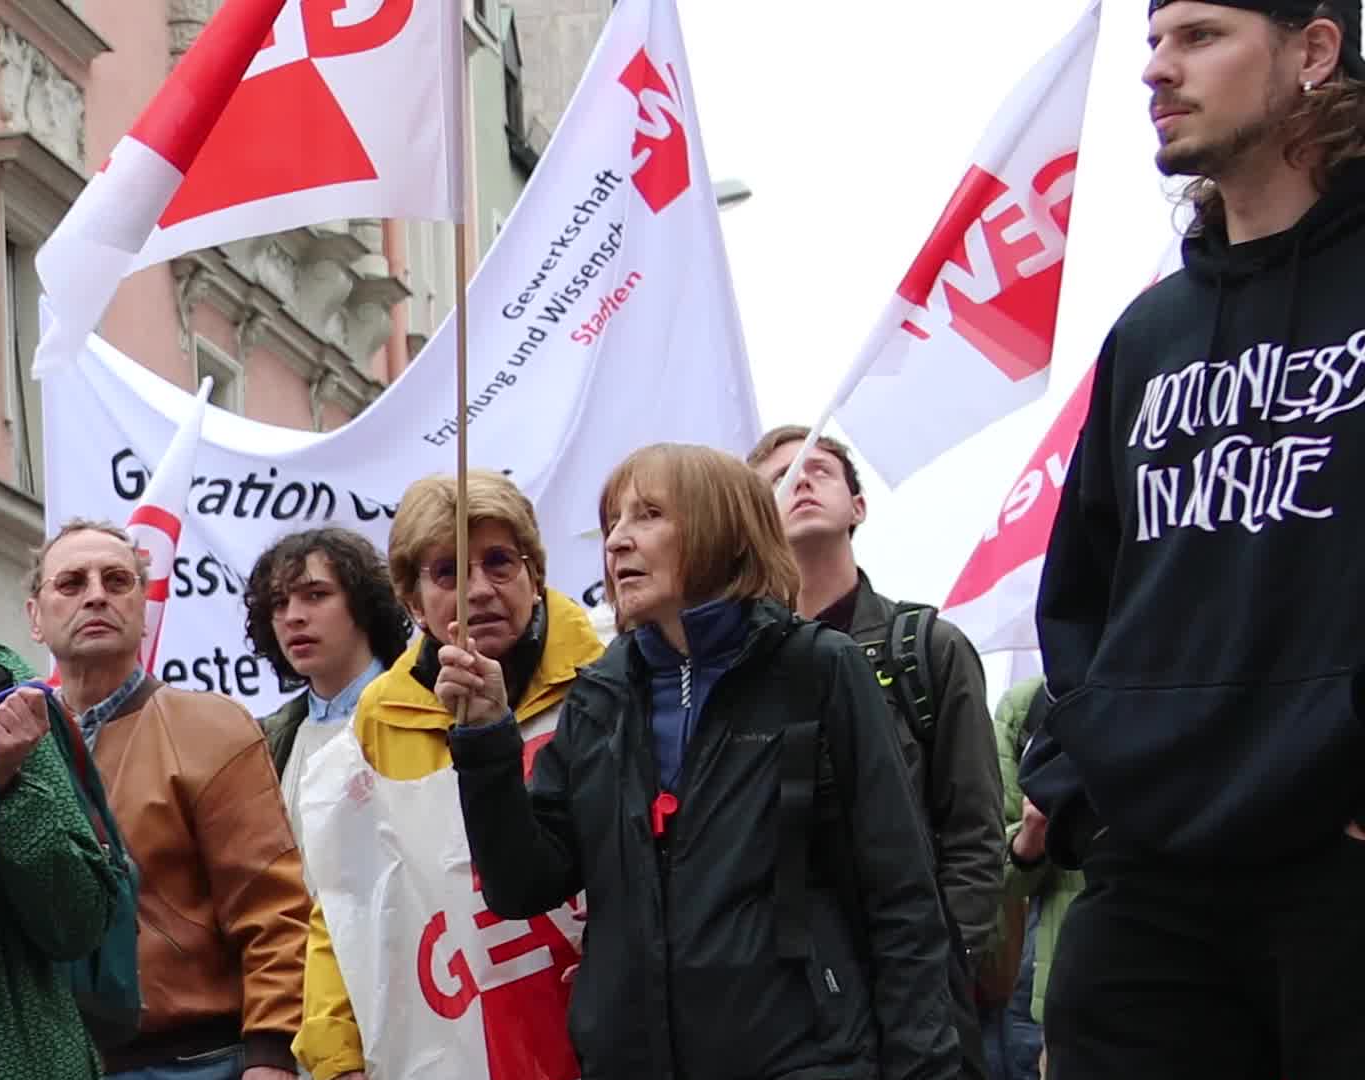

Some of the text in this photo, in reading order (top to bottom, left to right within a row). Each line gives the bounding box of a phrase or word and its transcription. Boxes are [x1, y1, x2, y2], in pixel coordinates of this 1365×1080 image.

[501, 168, 624, 321] Gewerkschaft
[506, 325, 549, 367] und
[1136, 463, 1181, 542] IN
